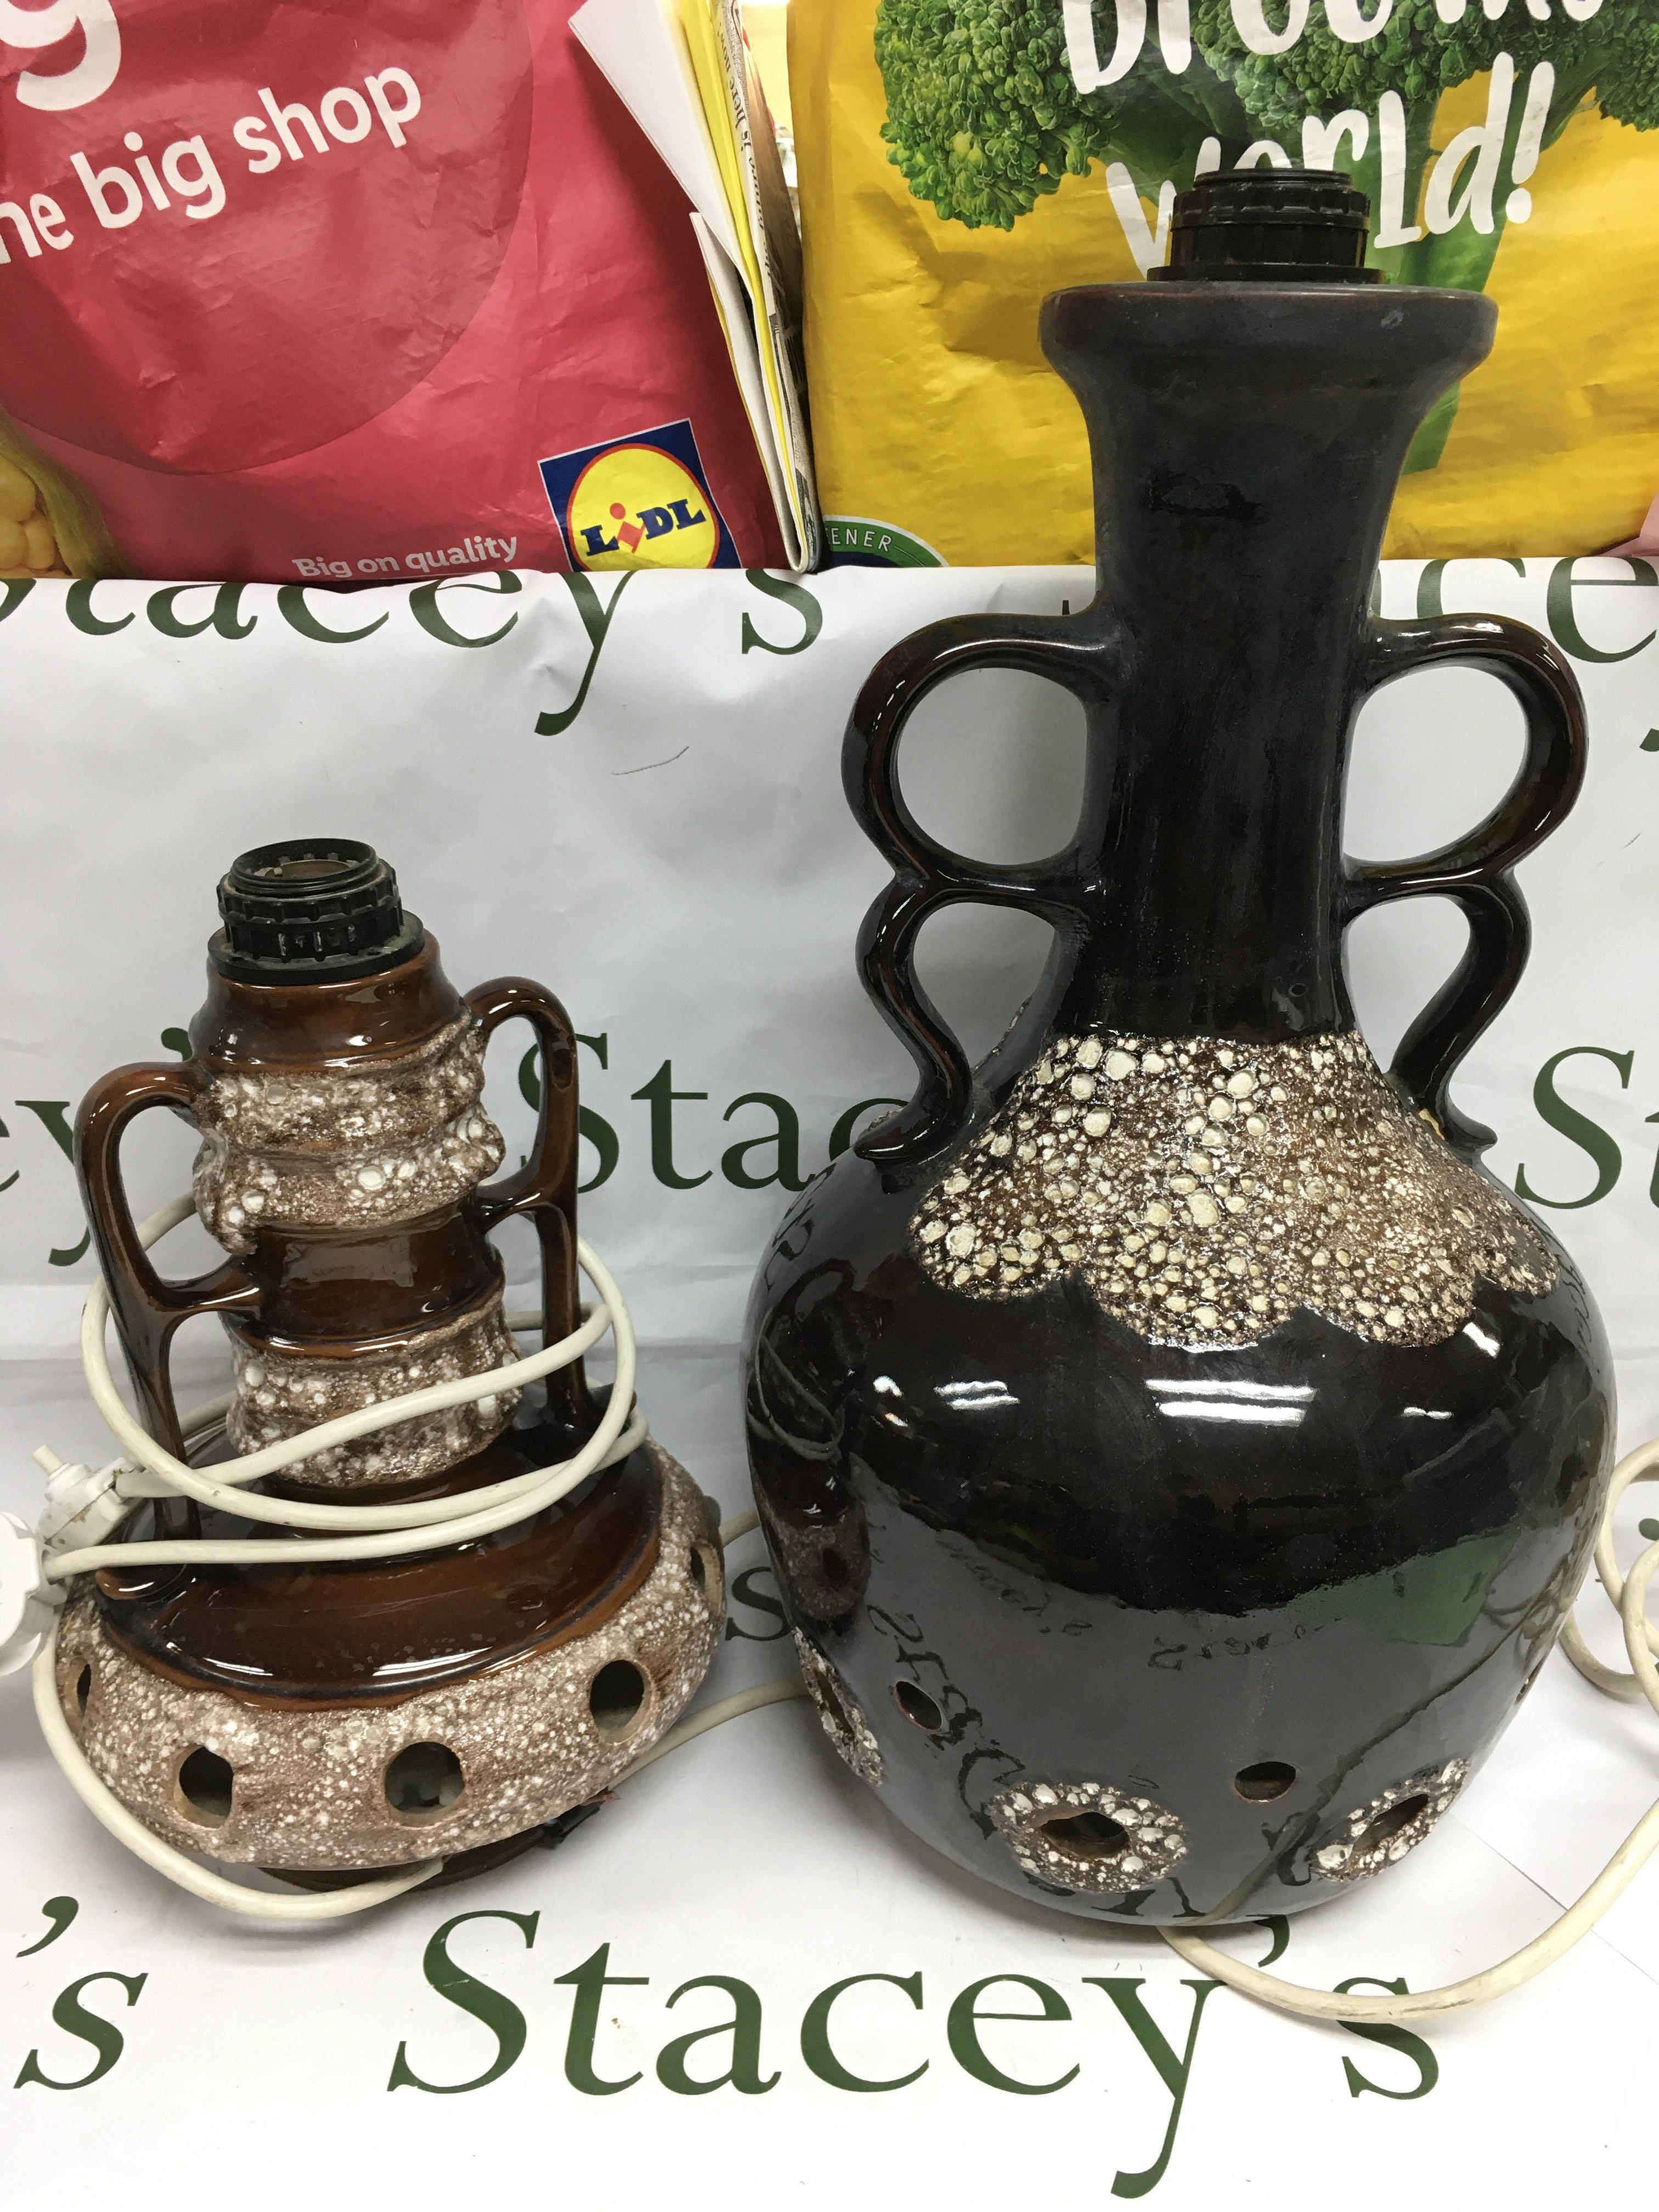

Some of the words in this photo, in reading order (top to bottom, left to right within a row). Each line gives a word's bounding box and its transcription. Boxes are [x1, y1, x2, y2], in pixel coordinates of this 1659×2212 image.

[70, 132, 226, 229] big
[233, 67, 421, 173] shop
[291, 556, 352, 578] Big
[357, 556, 400, 573] on
[405, 535, 517, 573] quality
[825, 527, 891, 552] ENER
[386, 1909, 1440, 2199] Stacey's
